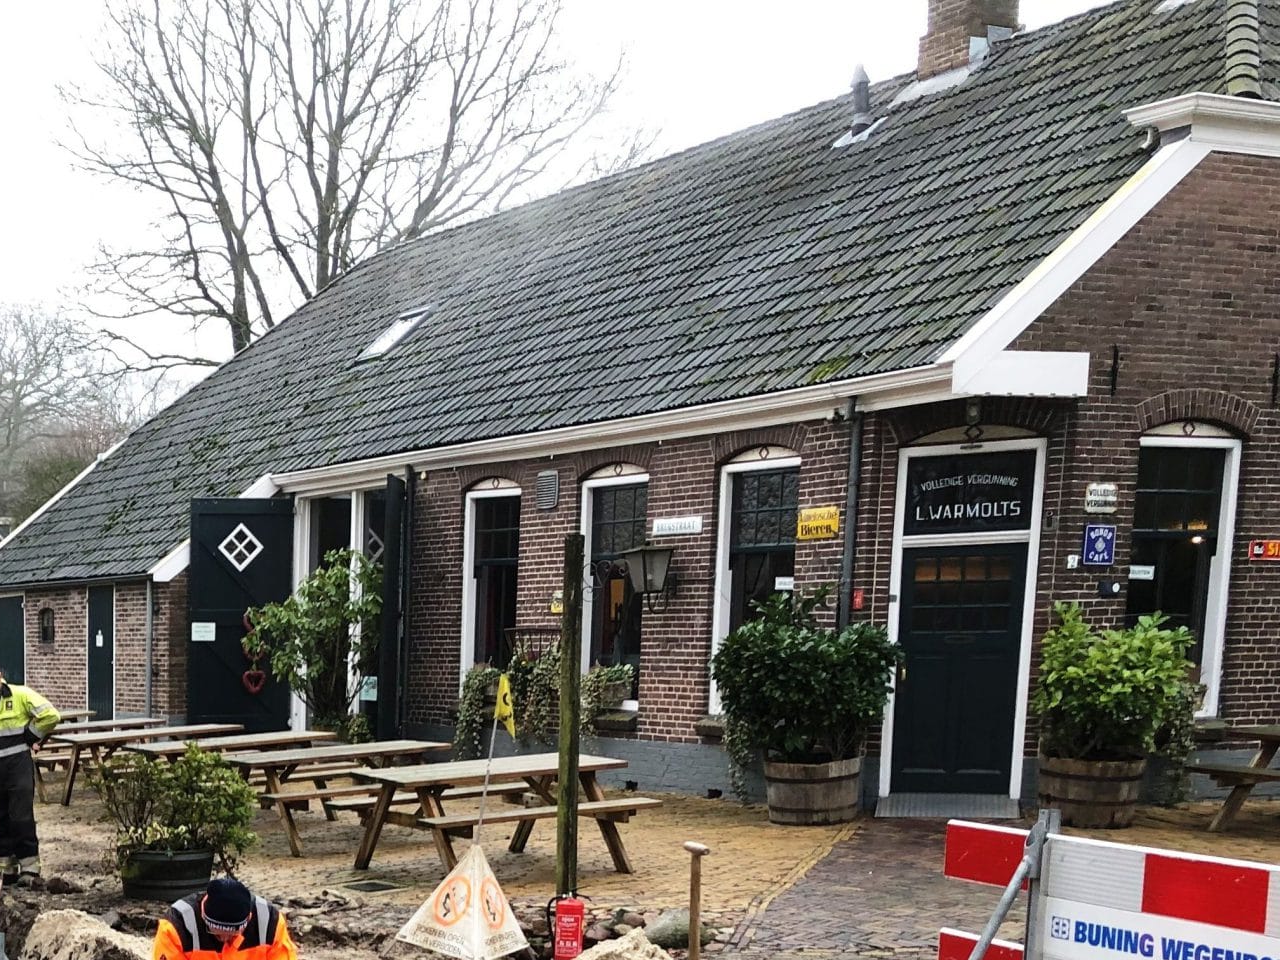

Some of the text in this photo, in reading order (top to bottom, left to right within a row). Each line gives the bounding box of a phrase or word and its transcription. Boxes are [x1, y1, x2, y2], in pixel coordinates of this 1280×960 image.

[921, 474, 1019, 491] VOLLEDIGE VERGUNNING
[1074, 921, 1154, 957] BUNING
